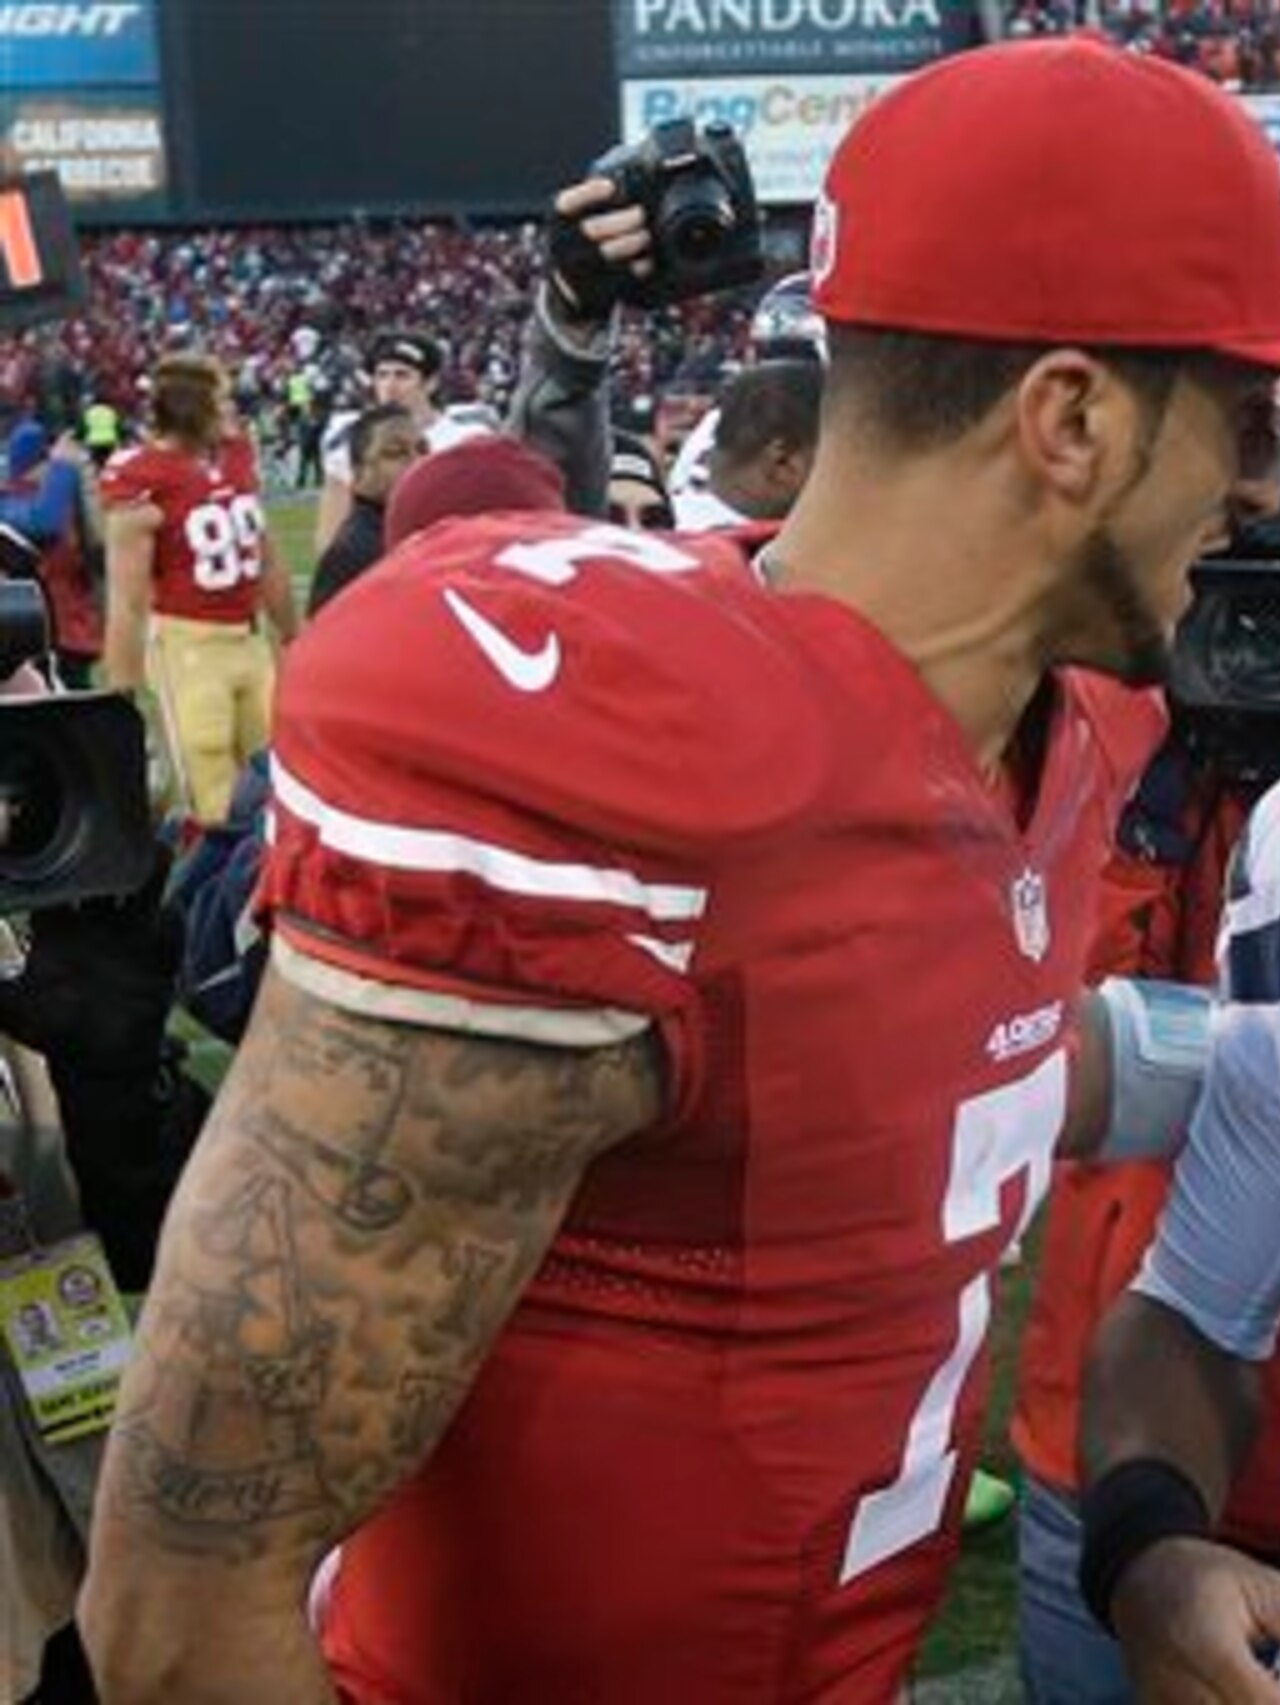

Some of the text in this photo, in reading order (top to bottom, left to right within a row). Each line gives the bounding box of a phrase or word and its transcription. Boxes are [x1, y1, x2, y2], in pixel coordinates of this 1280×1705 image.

[636, 0, 942, 32] PANDORA
[184, 493, 266, 590] 89
[839, 1048, 1069, 1587] 7
